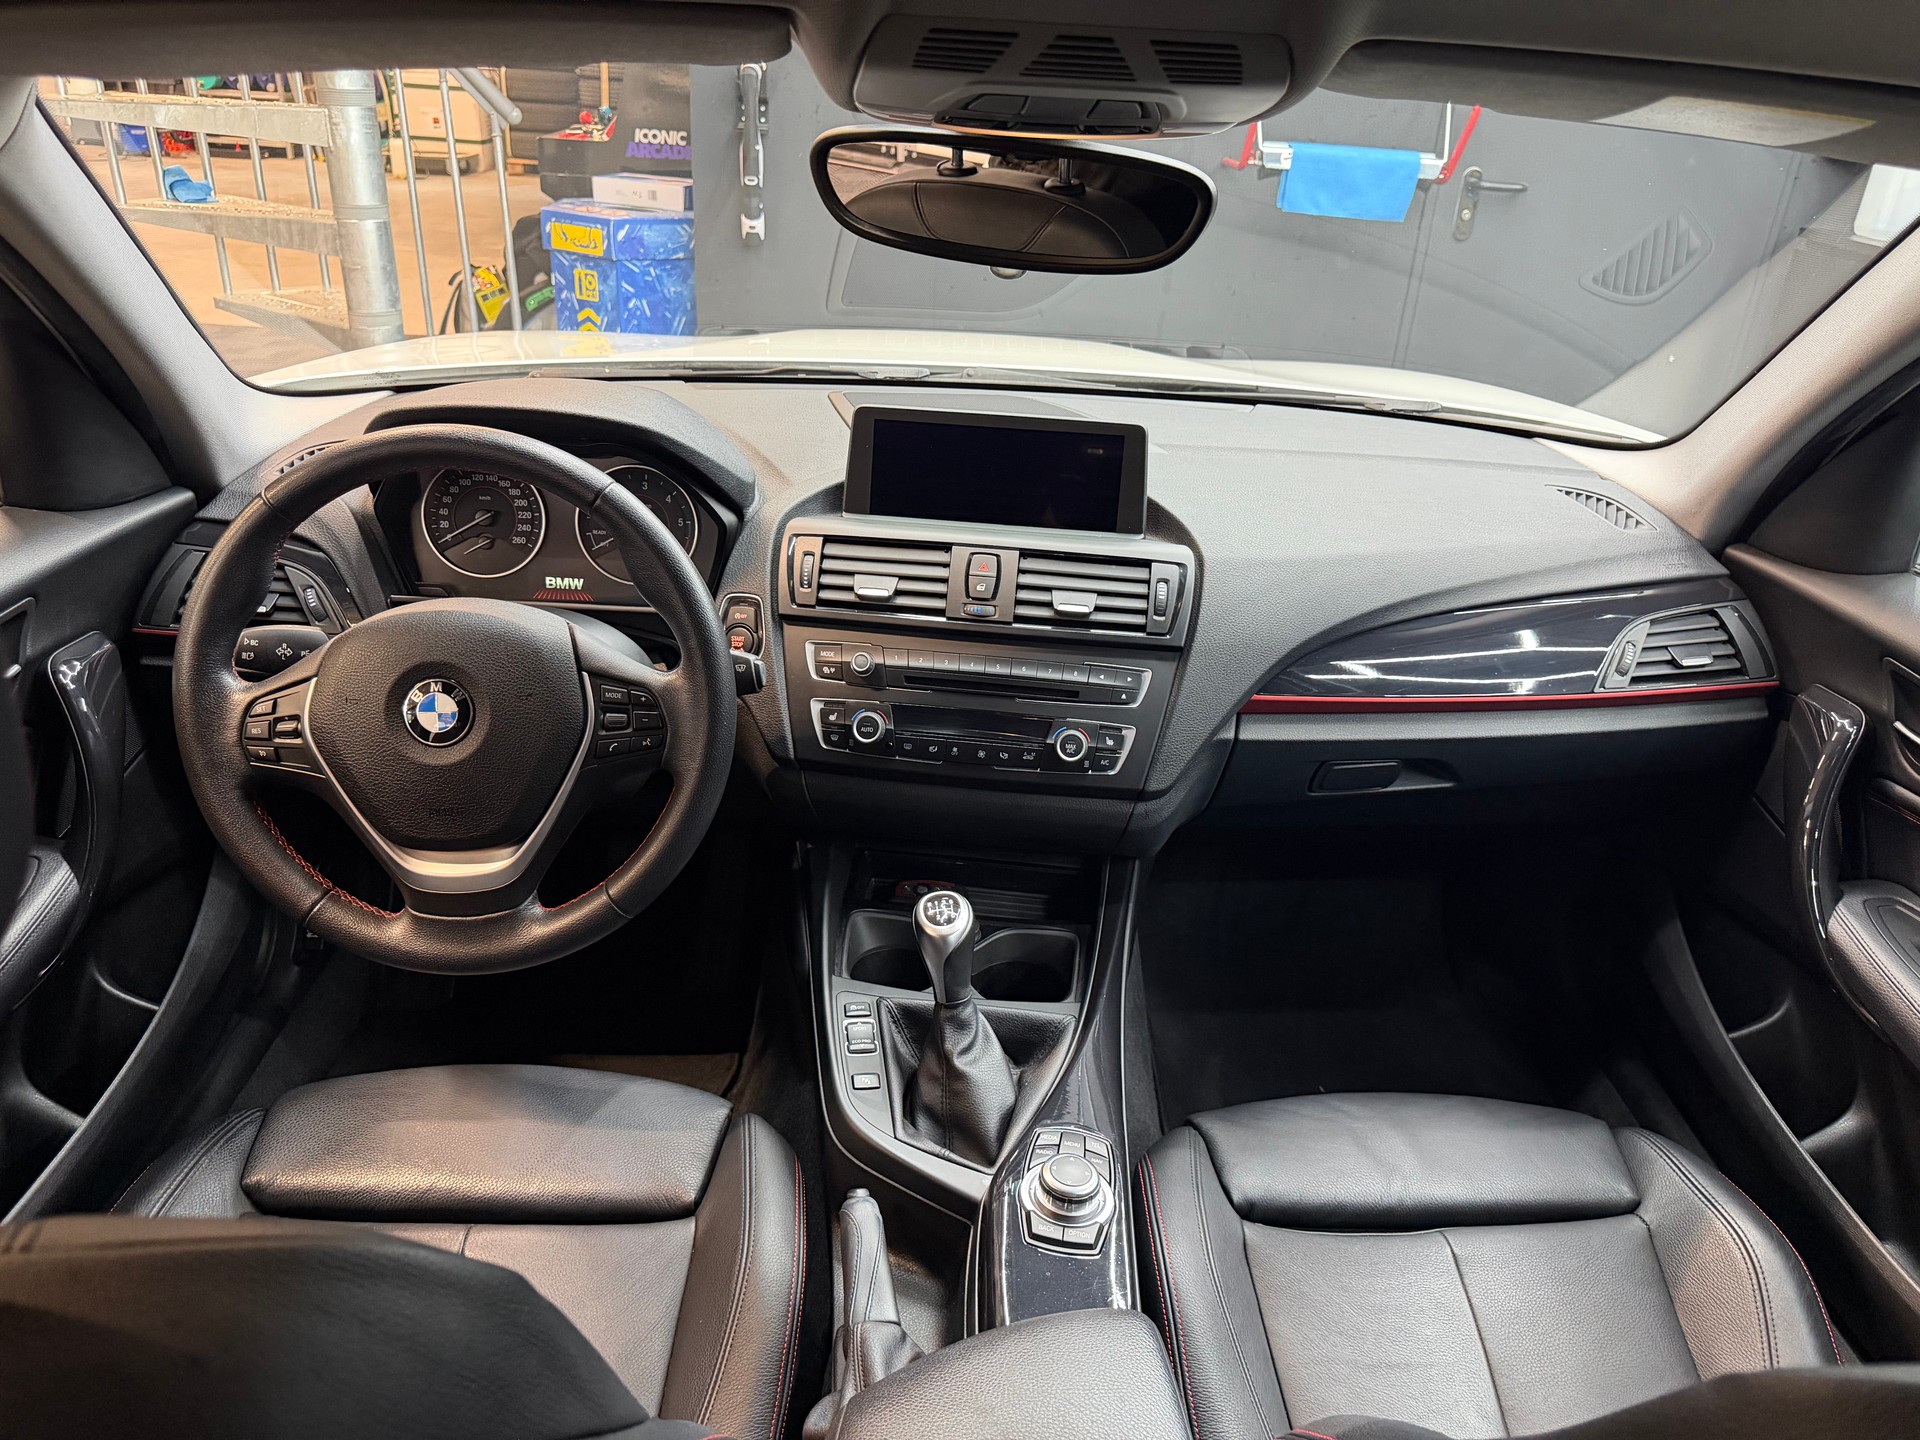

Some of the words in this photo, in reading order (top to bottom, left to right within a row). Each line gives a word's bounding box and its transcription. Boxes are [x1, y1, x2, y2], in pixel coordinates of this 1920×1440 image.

[634, 128, 688, 146] ICONIC
[642, 482, 648, 490] 3
[665, 495, 671, 503] 4
[678, 518, 684, 526] 5
[545, 576, 584, 590] BMW
[410, 682, 465, 702] BMW
